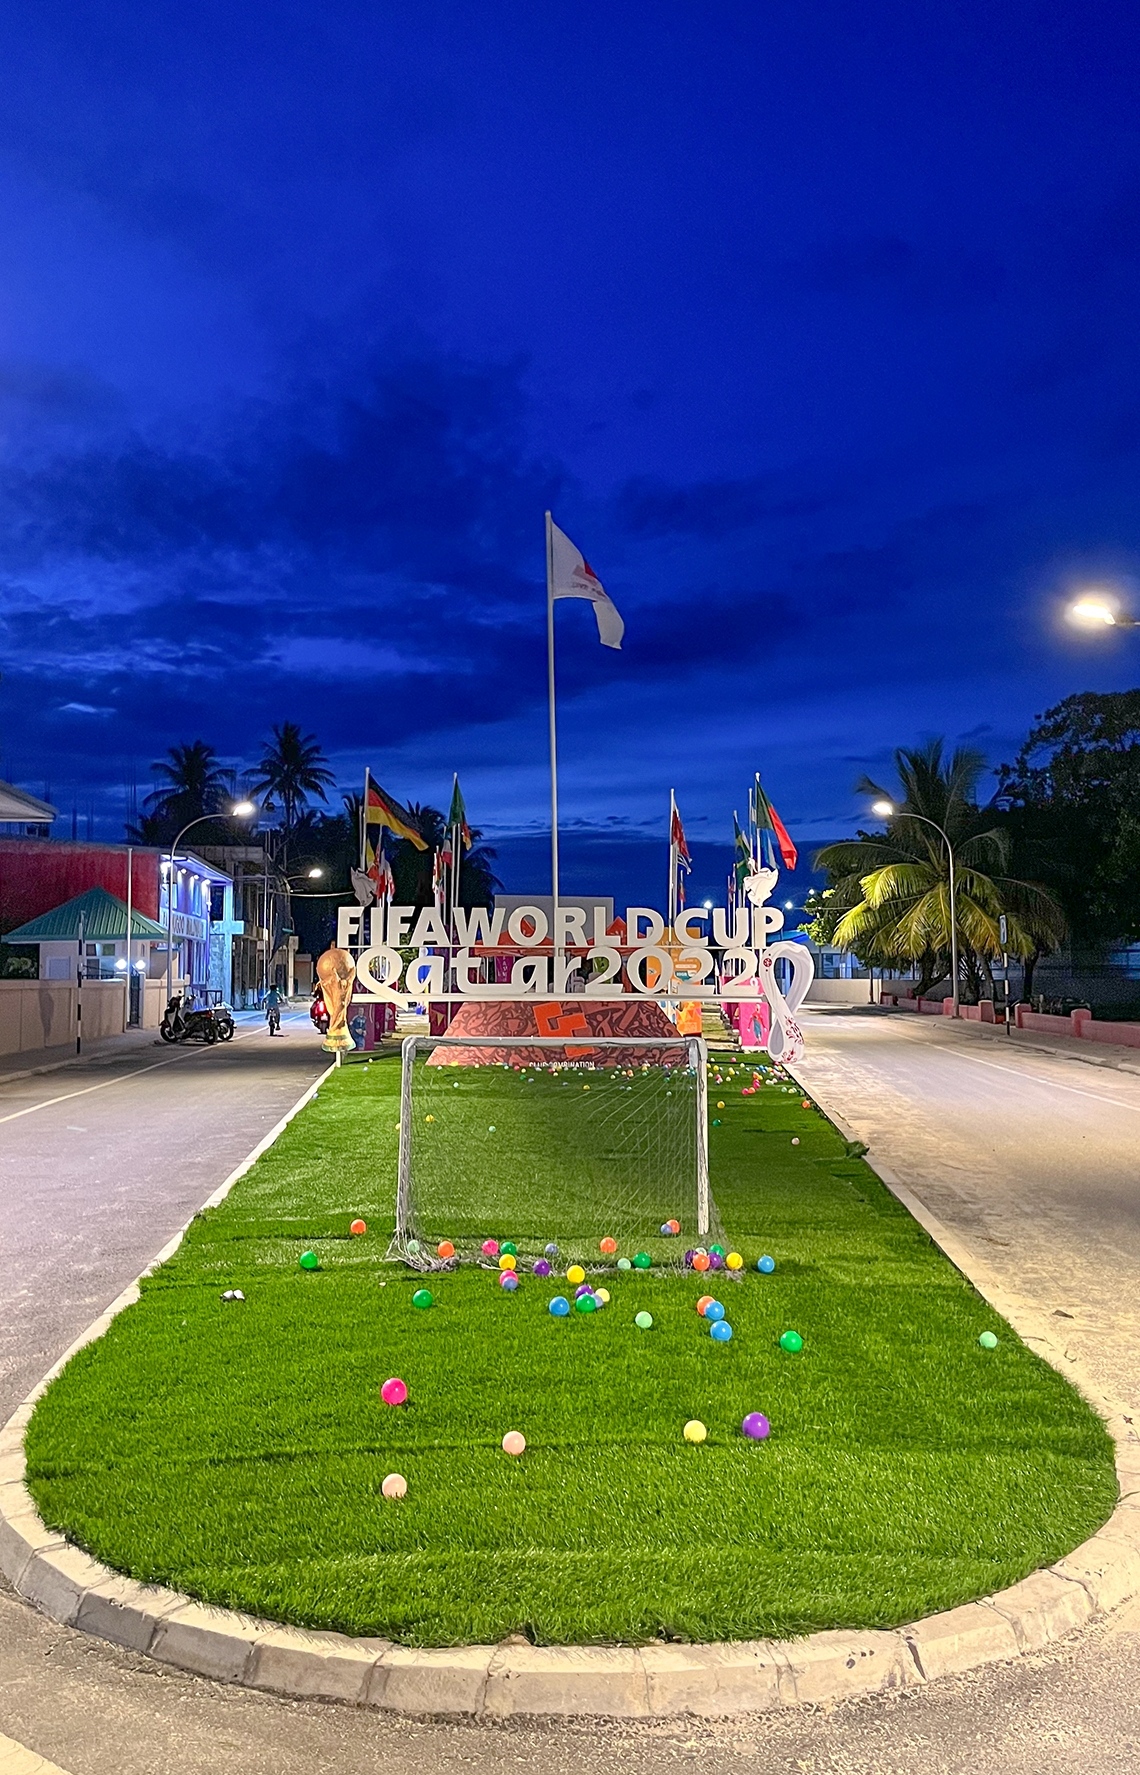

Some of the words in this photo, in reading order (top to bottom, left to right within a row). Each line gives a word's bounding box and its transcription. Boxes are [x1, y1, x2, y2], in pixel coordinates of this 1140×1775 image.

[337, 906, 451, 947] FIFA
[453, 905, 665, 947] WORLD
[674, 906, 785, 947] CUP
